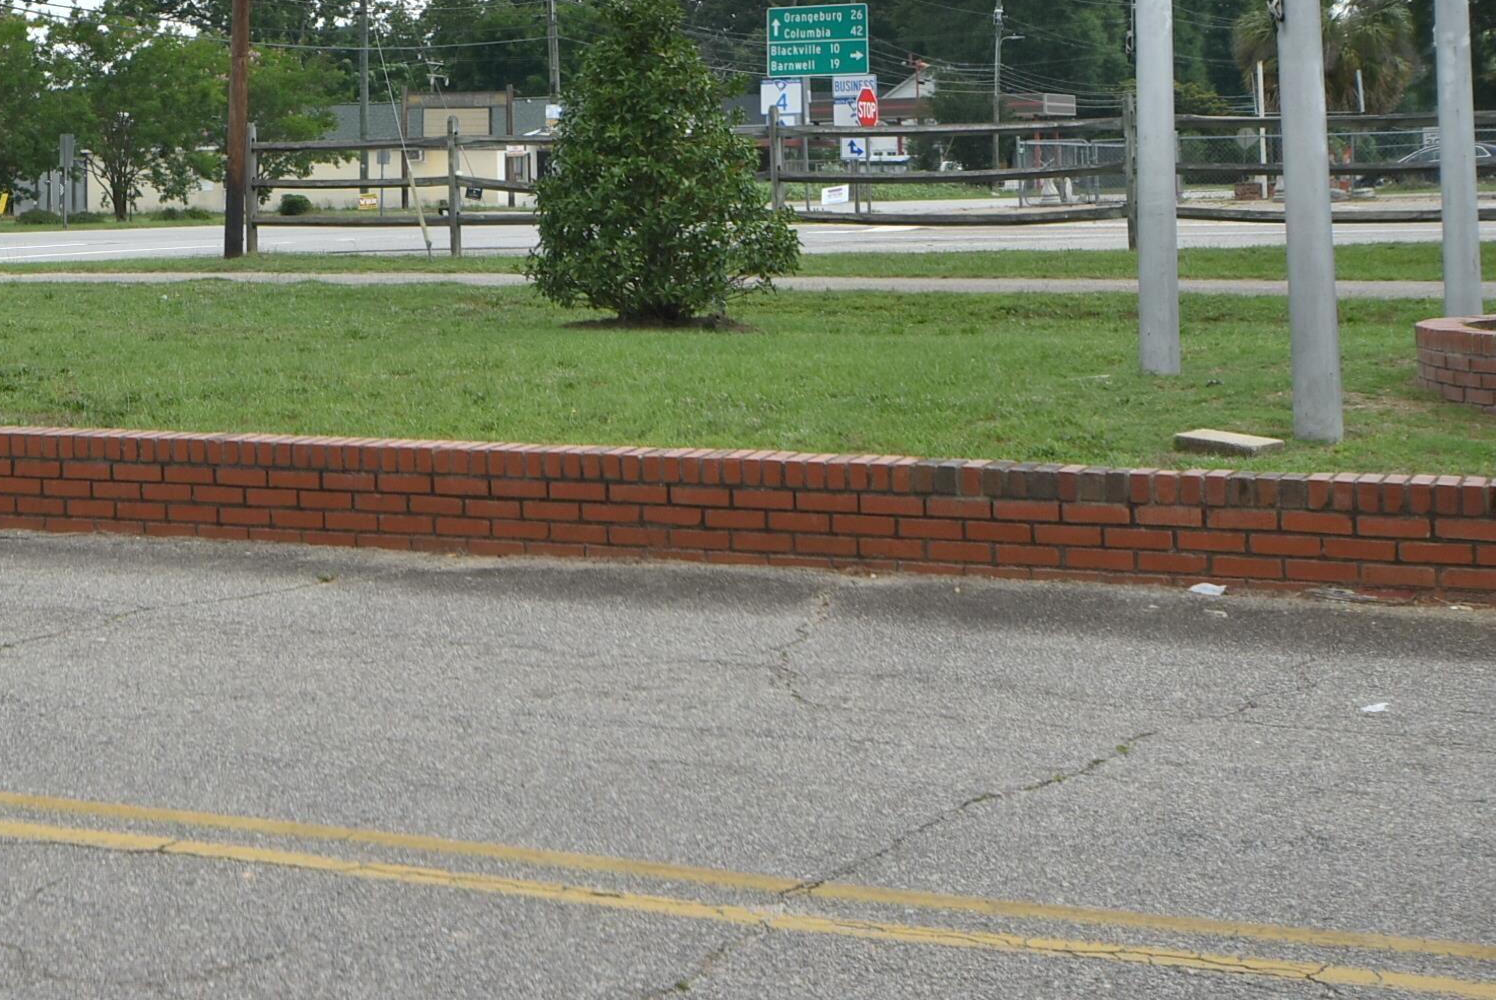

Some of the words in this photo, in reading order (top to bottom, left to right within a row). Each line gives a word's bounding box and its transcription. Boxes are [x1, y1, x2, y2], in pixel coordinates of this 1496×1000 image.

[784, 10, 843, 23] Orangeburg
[850, 9, 863, 21] 26
[784, 28, 832, 39] Columbia
[850, 26, 863, 37] 42
[770, 43, 822, 56] Blackville
[829, 43, 840, 55] 10
[770, 60, 816, 72] Barnwell
[829, 58, 840, 70] 19
[775, 93, 788, 112] 4
[858, 102, 877, 118] STOP
